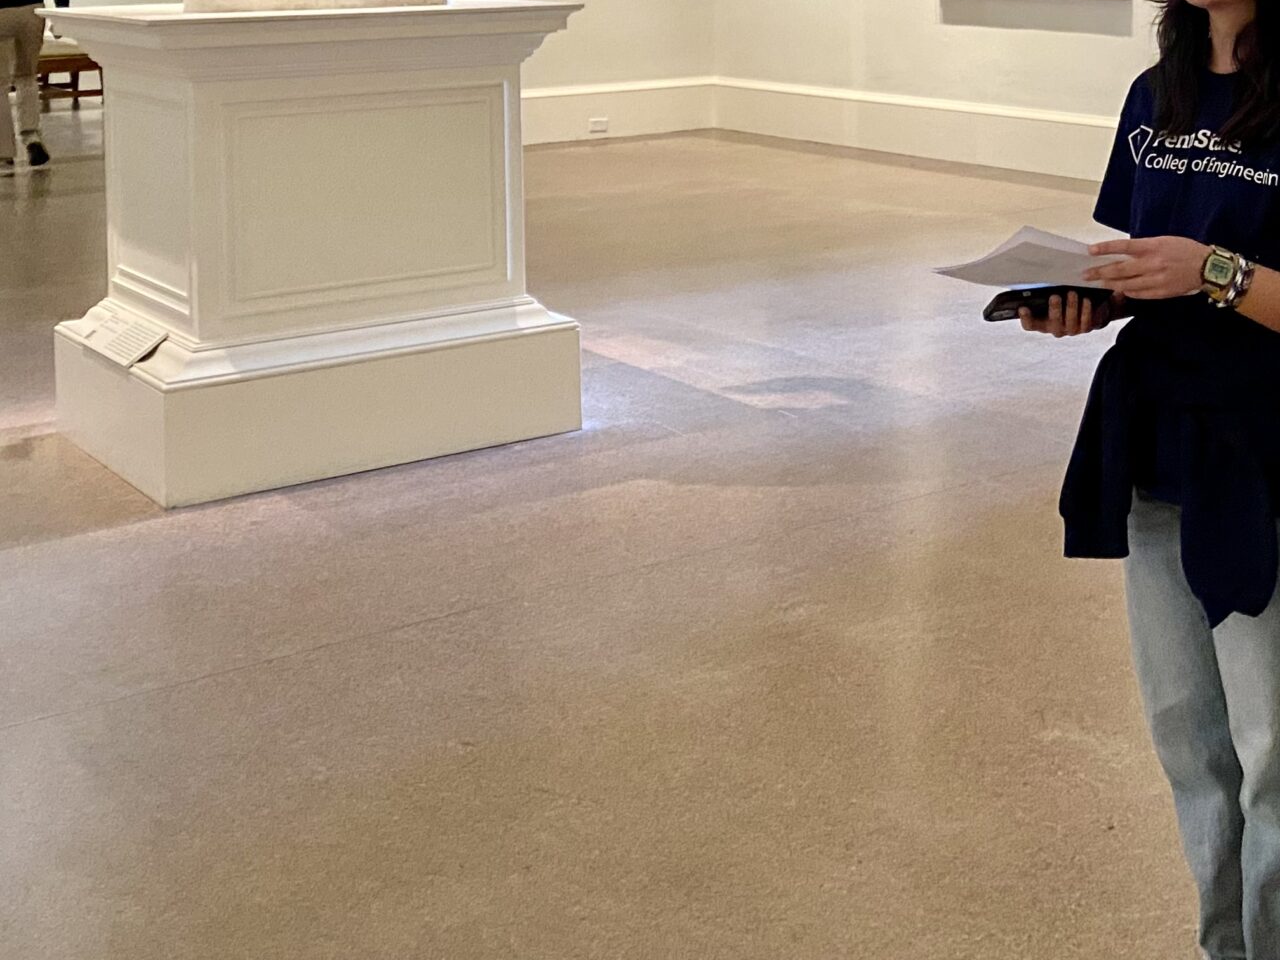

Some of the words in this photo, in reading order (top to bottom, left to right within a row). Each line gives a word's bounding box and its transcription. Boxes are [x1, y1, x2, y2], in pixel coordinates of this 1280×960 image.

[1152, 129, 1241, 153] PenSte
[1144, 153, 1188, 174] Colleg
[1191, 156, 1210, 172] of
